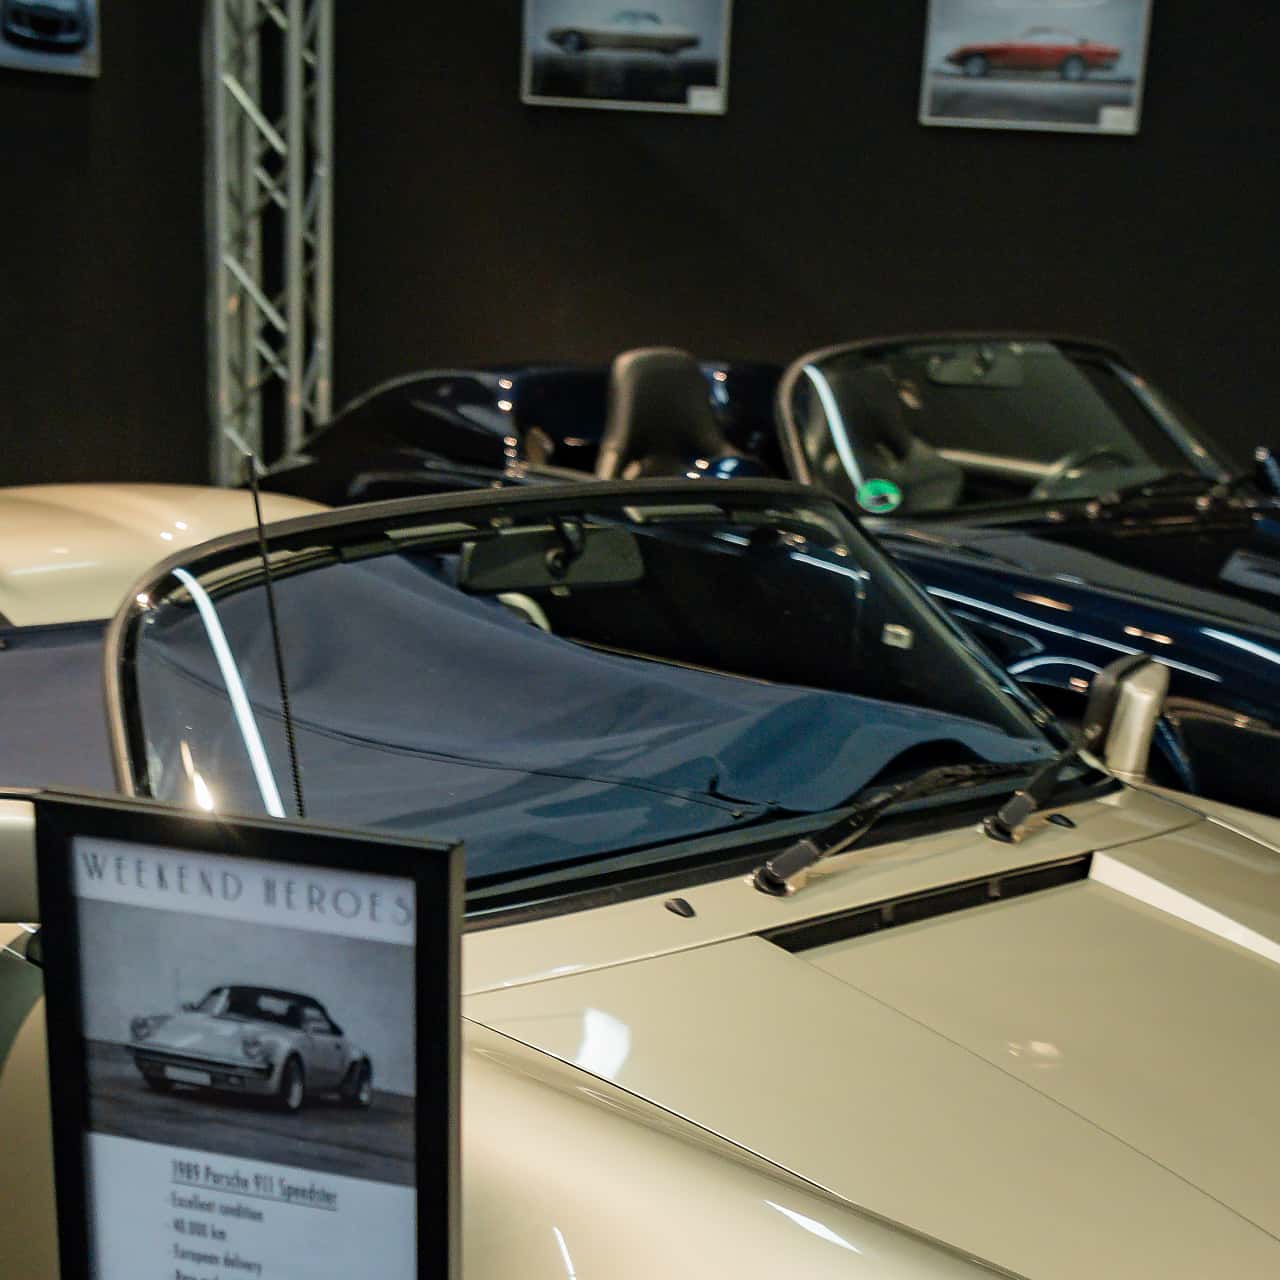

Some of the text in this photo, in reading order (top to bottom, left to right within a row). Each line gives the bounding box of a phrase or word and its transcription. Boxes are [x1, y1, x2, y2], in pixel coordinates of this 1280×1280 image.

[82, 852, 413, 926] WEEKEND HEROES
[172, 1160, 337, 1204] 1989 Porsche 911 Speedster
[171, 1191, 263, 1222] Excellent condition
[173, 1243, 262, 1277] European delivery
